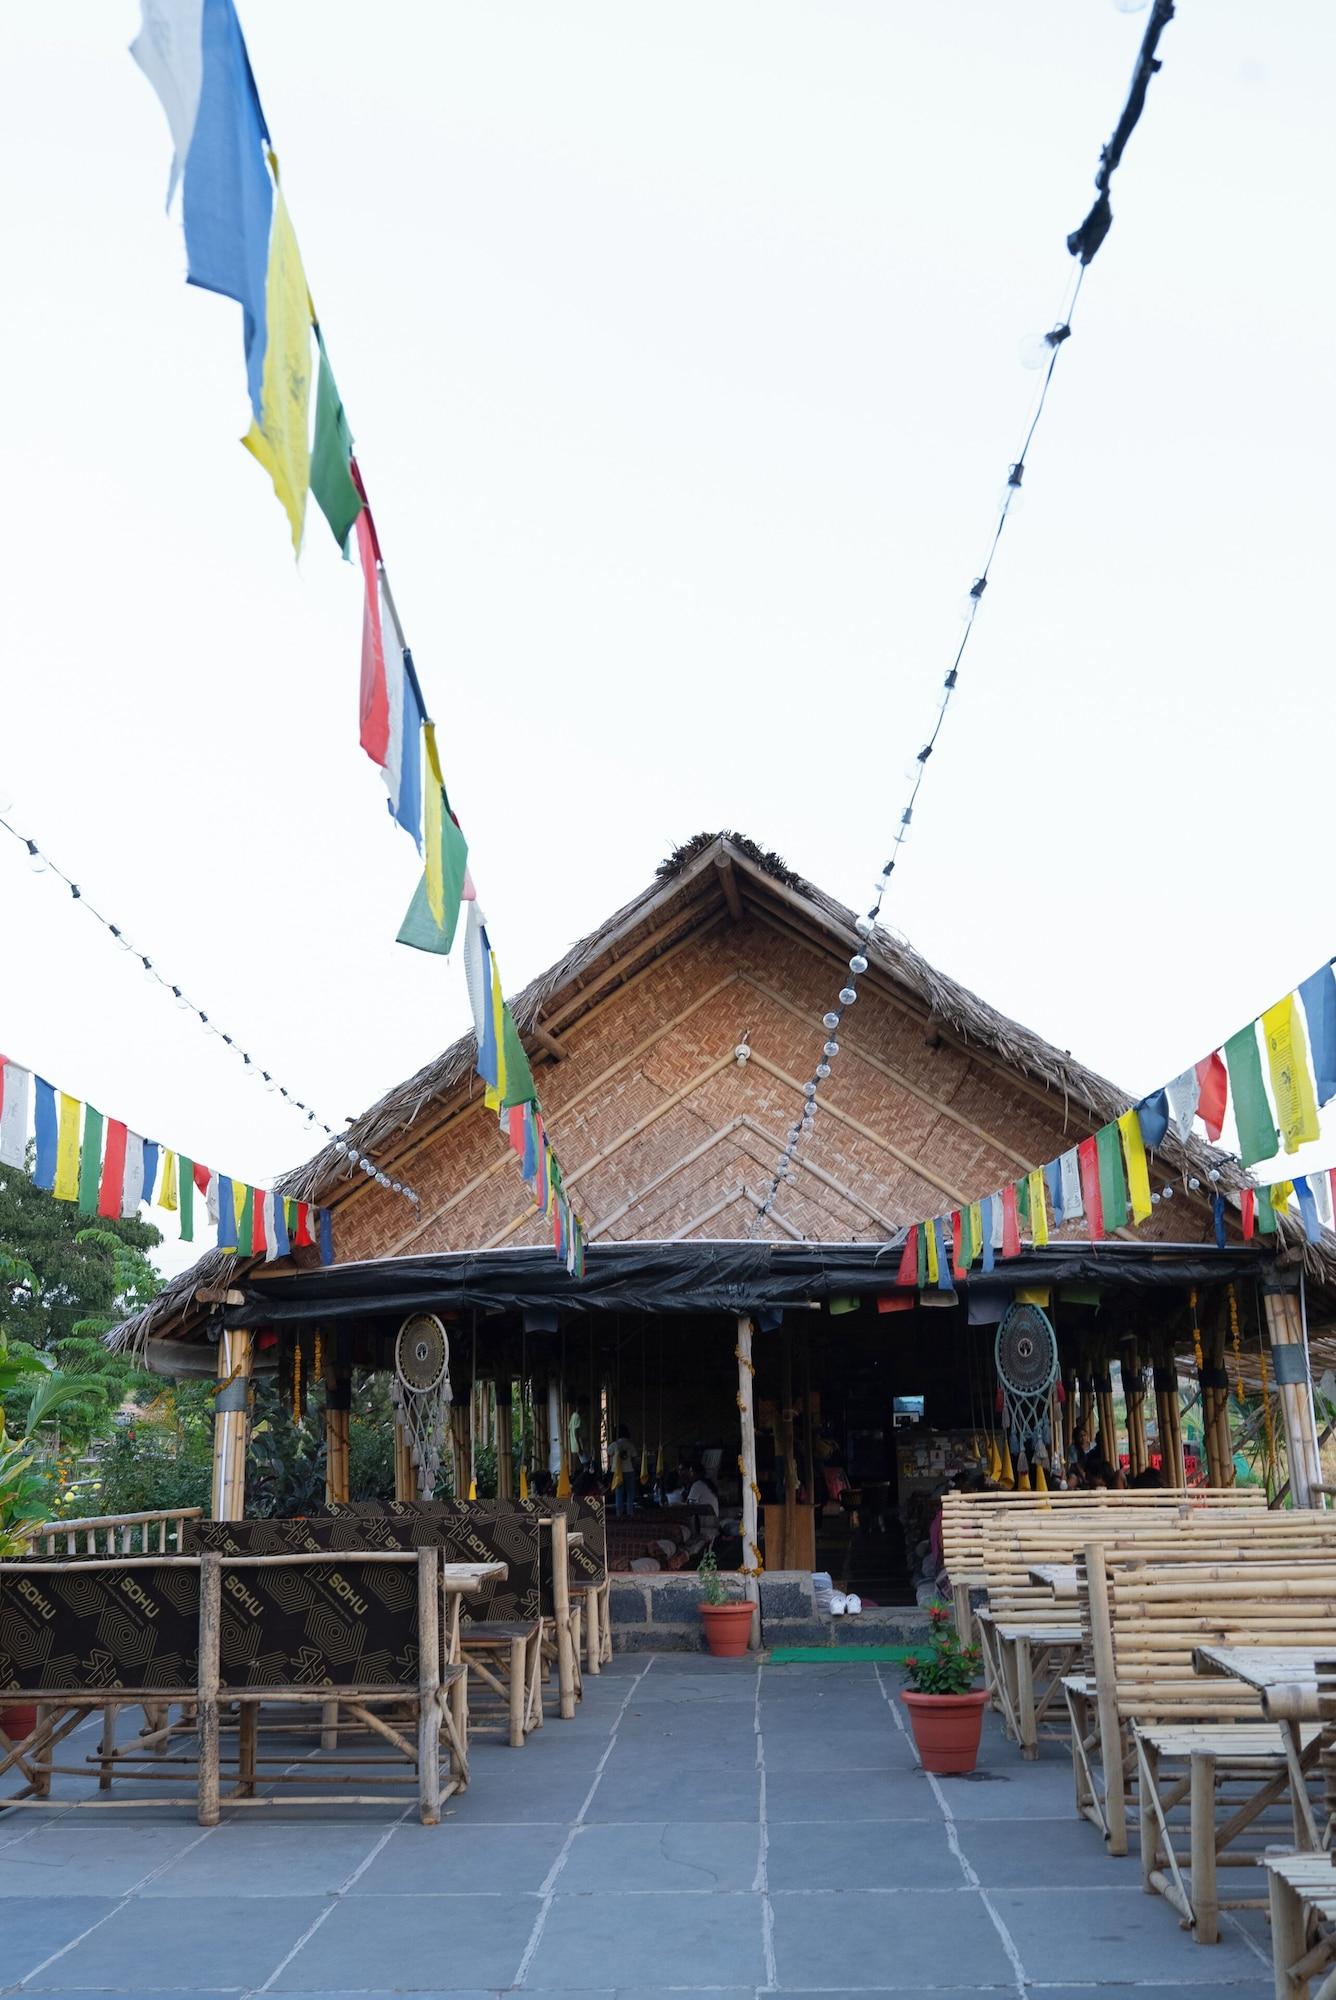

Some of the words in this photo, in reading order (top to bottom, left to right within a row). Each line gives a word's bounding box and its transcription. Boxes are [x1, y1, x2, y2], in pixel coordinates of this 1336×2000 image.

[571, 1548, 597, 1574] SOHU
[17, 1579, 56, 1620] SOHU
[120, 1576, 160, 1618] SOHU
[225, 1575, 264, 1617] SOHU
[328, 1573, 368, 1615] SOHU
